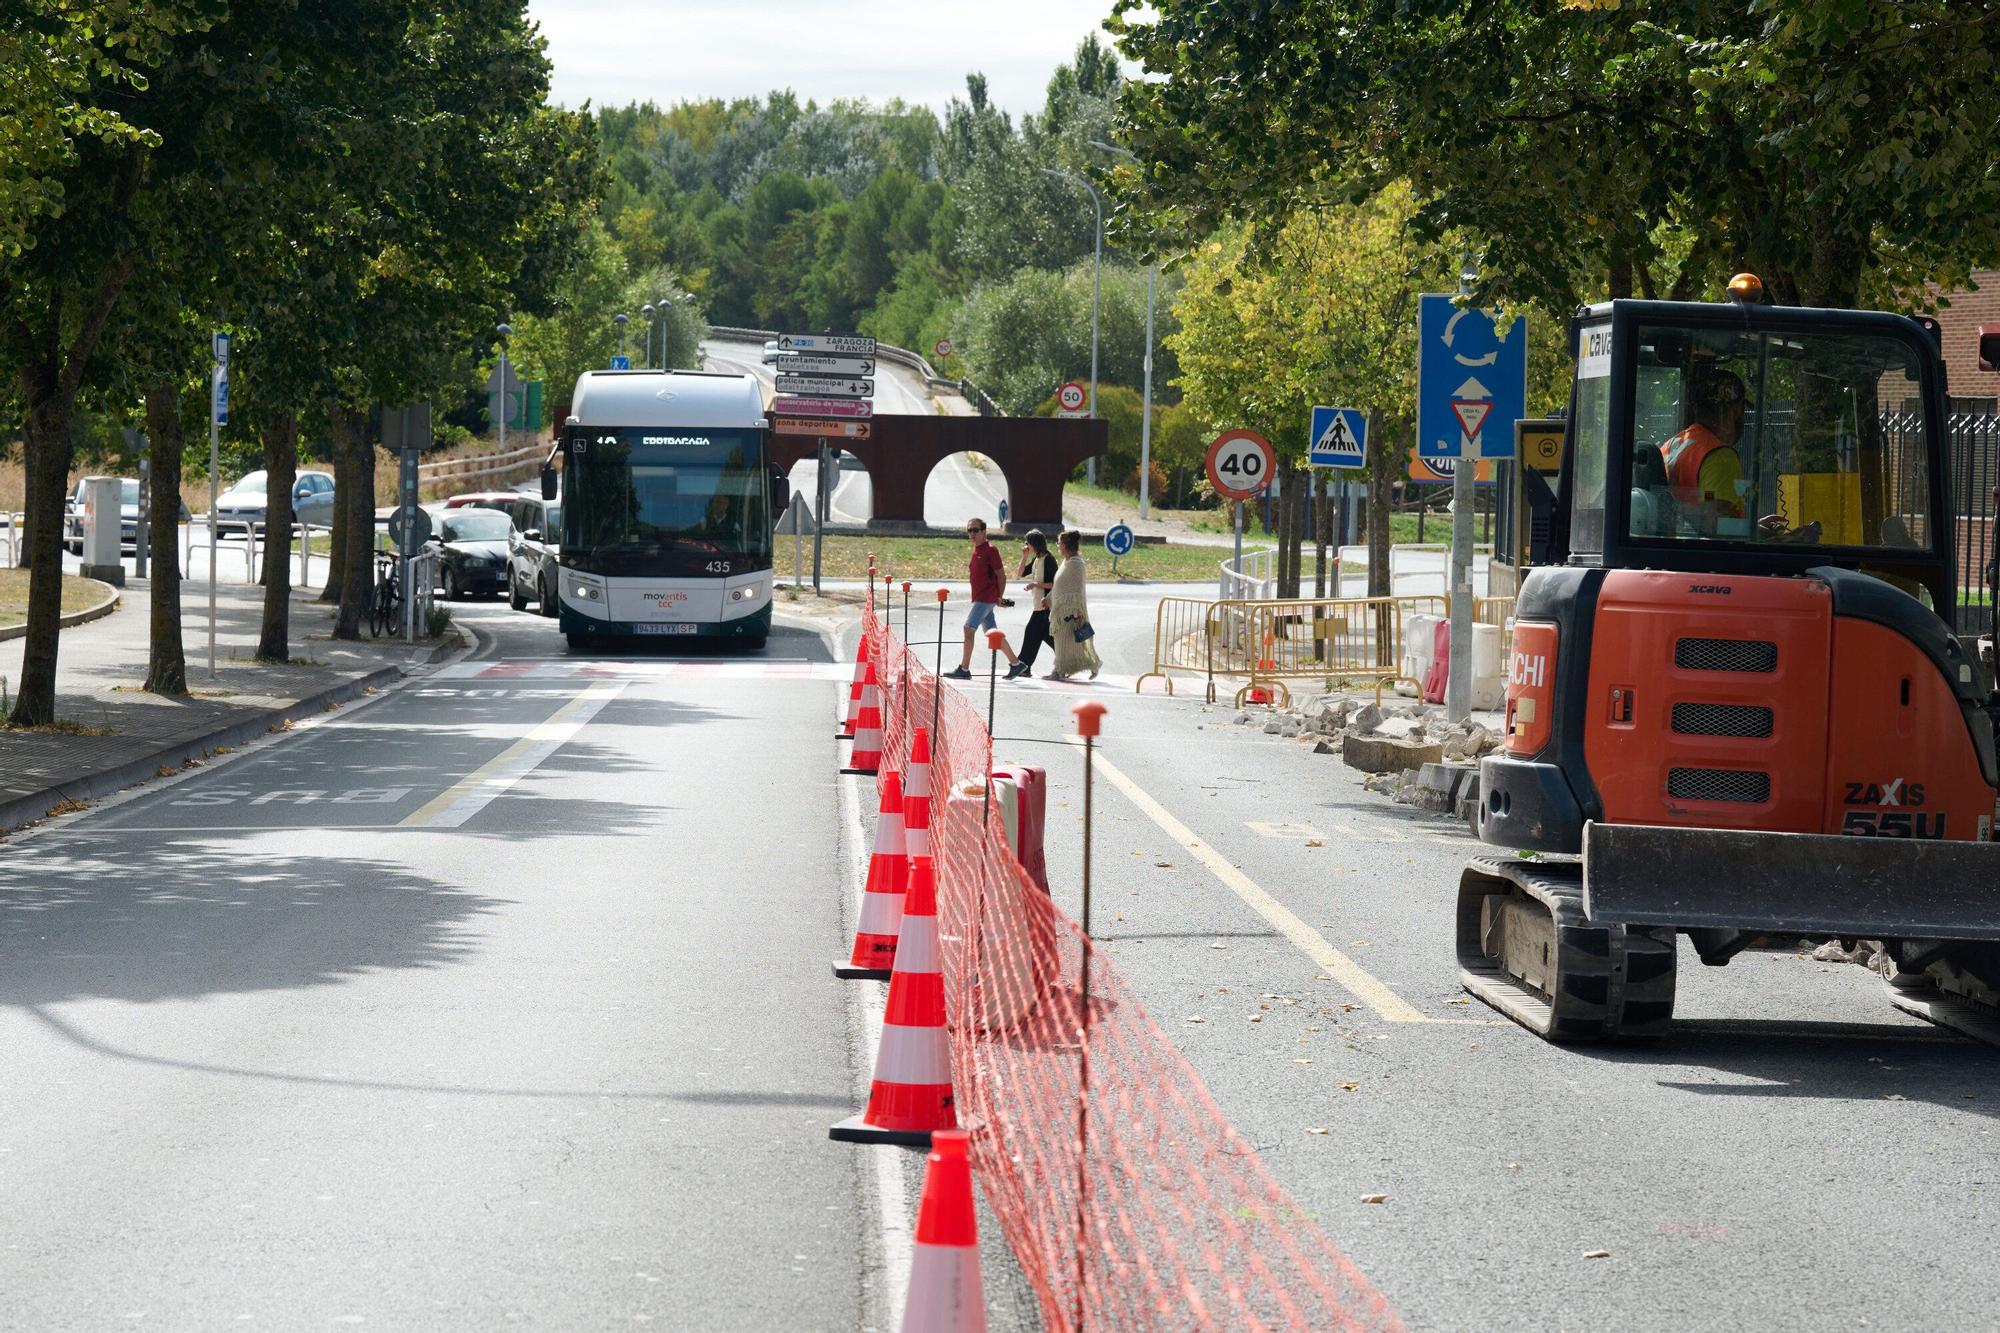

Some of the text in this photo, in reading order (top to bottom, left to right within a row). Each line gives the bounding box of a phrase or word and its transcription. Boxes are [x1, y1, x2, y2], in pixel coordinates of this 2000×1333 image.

[826, 337, 874, 346] ZARAGOZA
[780, 356, 837, 365] ayuntamiento
[807, 379, 844, 387] municipal
[1064, 391, 1080, 401] 50
[798, 419, 839, 428] deportiva
[1221, 453, 1261, 476] 40
[705, 561, 730, 573] 435
[1688, 584, 1732, 595] xcava
[1844, 777, 1926, 806] ZAXIS
[1841, 811, 1947, 840] 55U
